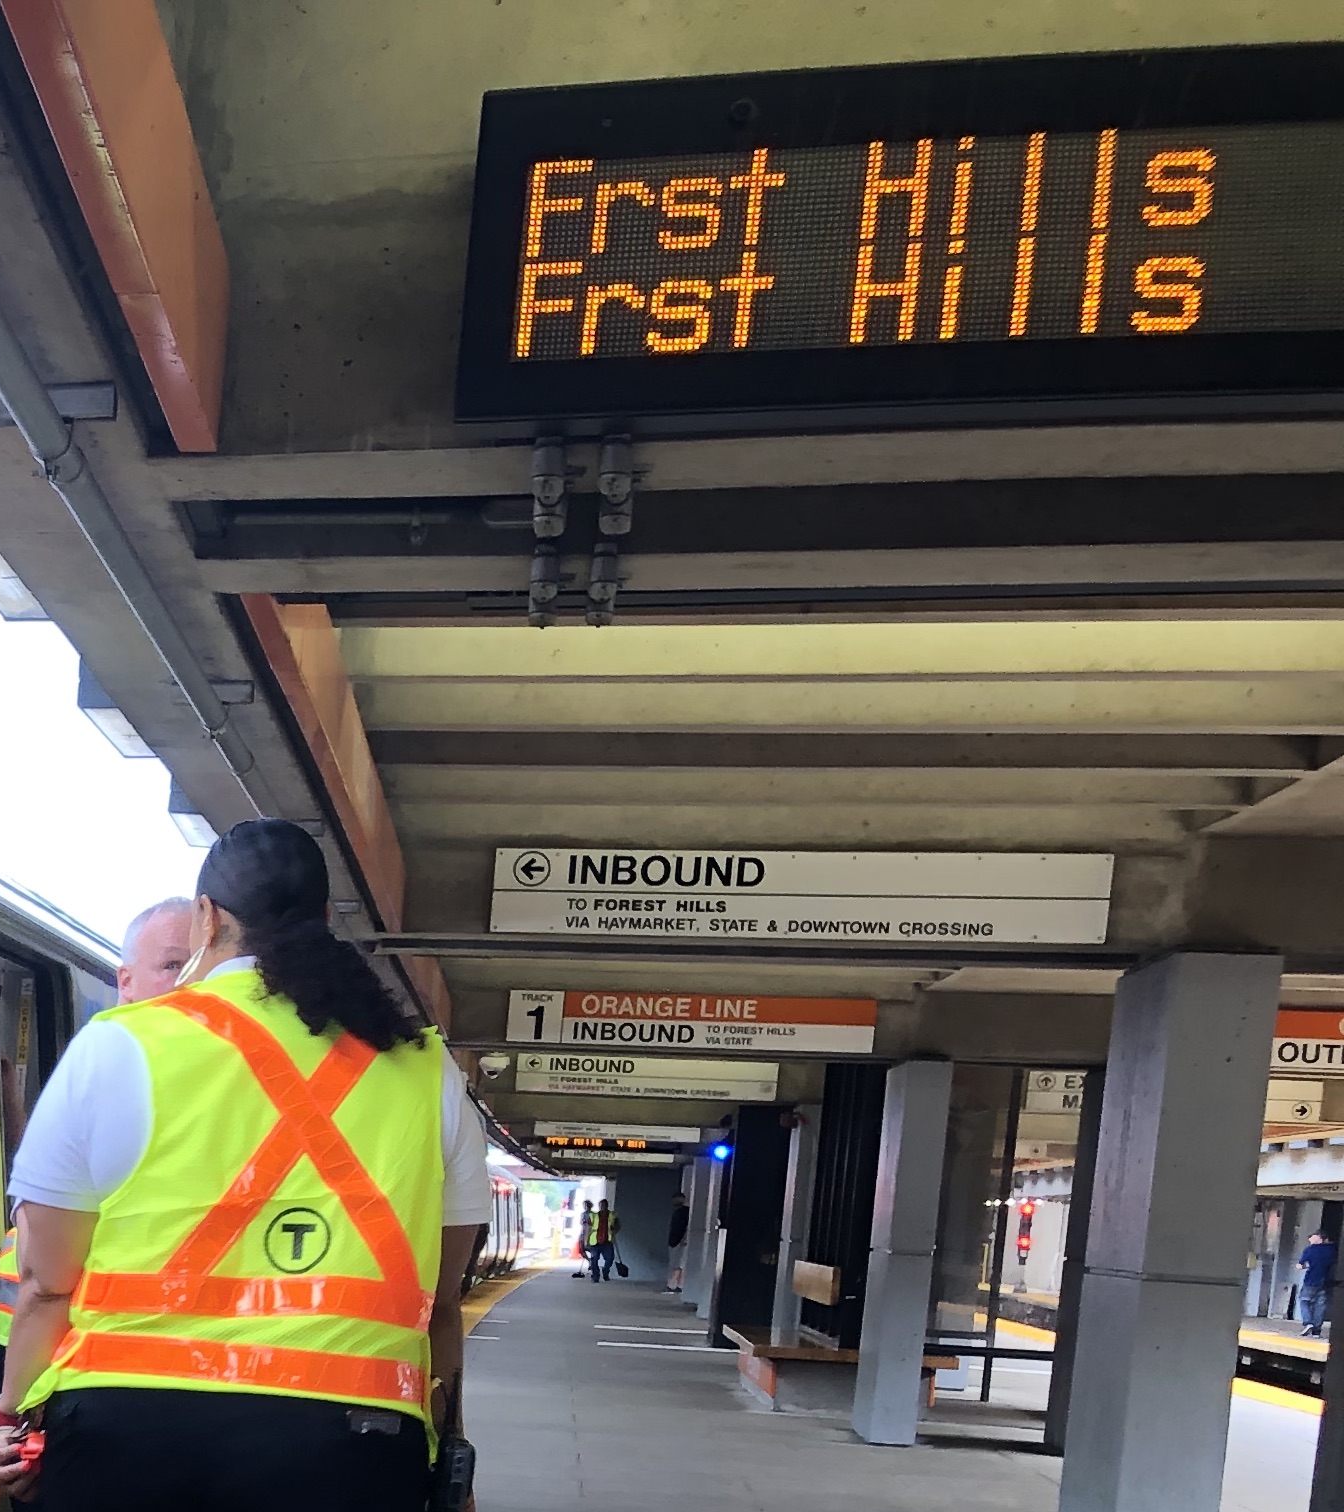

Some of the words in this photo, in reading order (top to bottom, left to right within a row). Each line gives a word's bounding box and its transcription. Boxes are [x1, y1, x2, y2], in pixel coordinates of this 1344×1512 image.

[525, 147, 787, 258] Frst
[859, 129, 1218, 240] Hills
[515, 251, 775, 358] Frst
[848, 234, 1206, 343] Hills
[568, 854, 765, 887] INBOUND
[566, 898, 587, 911] TO
[593, 898, 667, 912] FOREST
[676, 900, 727, 913] HILLS
[565, 916, 590, 929] VIA
[709, 918, 758, 932] STATE
[767, 920, 778, 932] &
[788, 920, 890, 935] DOWNTOWN
[898, 921, 994, 937] CROSSING
[521, 993, 553, 1002] TRACK
[581, 994, 691, 1018] ORANGE
[700, 999, 758, 1020] LINE
[526, 1005, 544, 1040] 1
[572, 1021, 695, 1044] INBOUND
[706, 1025, 720, 1034] TO
[723, 1025, 764, 1035] FOREST
[766, 1027, 796, 1036] HILLS
[705, 1036, 721, 1045] VIA
[724, 1036, 753, 1046] STATE
[1277, 1041, 1344, 1065] OUT
[549, 1057, 635, 1073] INBOUND
